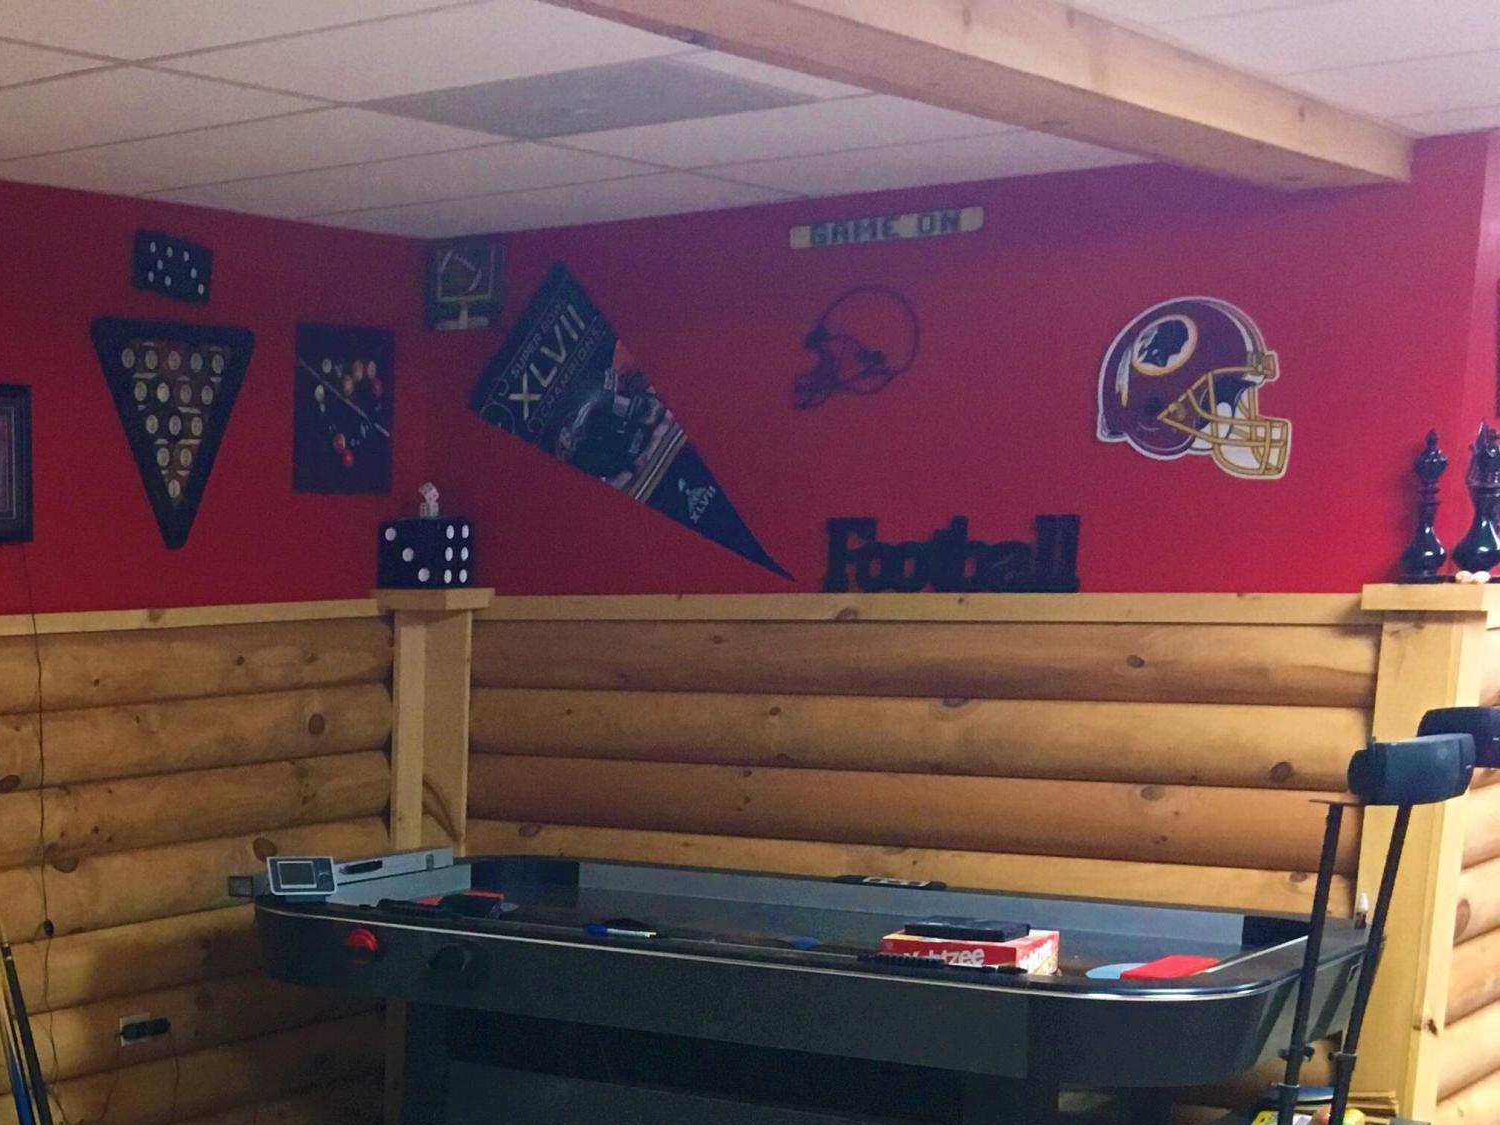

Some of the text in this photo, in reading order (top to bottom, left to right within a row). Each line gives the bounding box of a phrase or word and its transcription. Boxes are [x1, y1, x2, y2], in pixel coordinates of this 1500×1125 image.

[811, 207, 960, 246] GAME ON
[508, 303, 586, 421] XLVII
[510, 332, 544, 379] SUPER
[689, 485, 716, 524] XLVII
[821, 514, 1080, 593] Football
